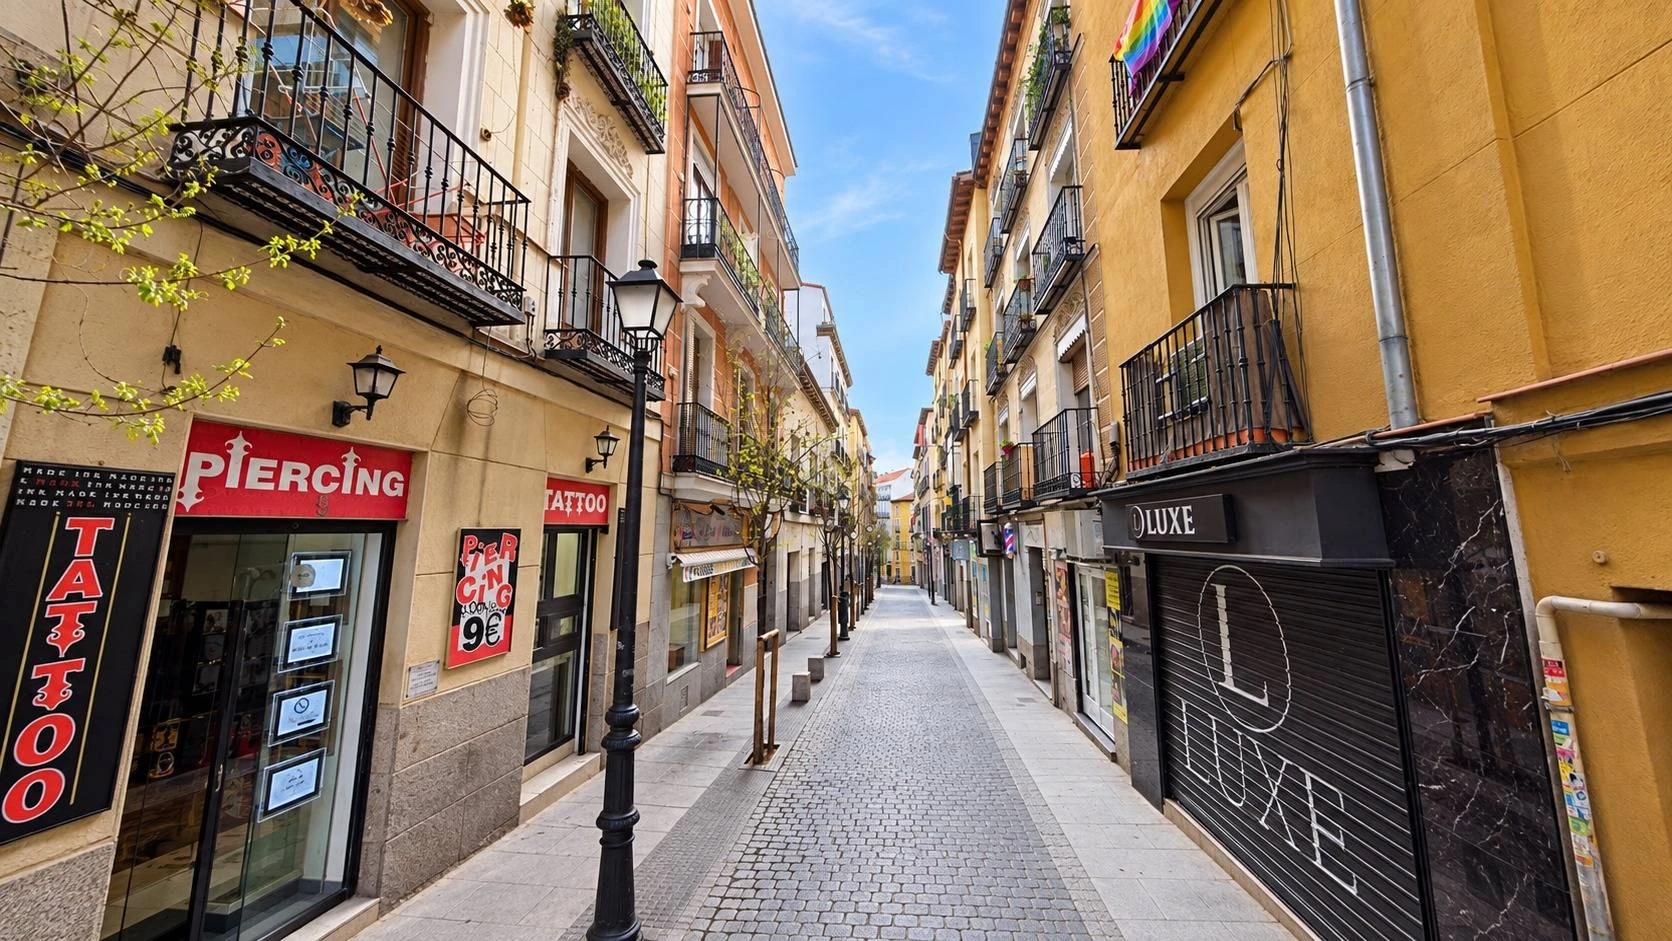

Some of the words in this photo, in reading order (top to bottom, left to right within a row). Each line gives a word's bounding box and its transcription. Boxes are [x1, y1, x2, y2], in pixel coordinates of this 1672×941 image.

[177, 431, 405, 512] PIERCING
[544, 489, 607, 518] TATTOO
[1145, 505, 1196, 535] LUXE
[2, 515, 116, 825] TATTOO
[462, 611, 502, 652] 9€
[1210, 582, 1270, 708] L
[1178, 698, 1359, 897] LUXE
